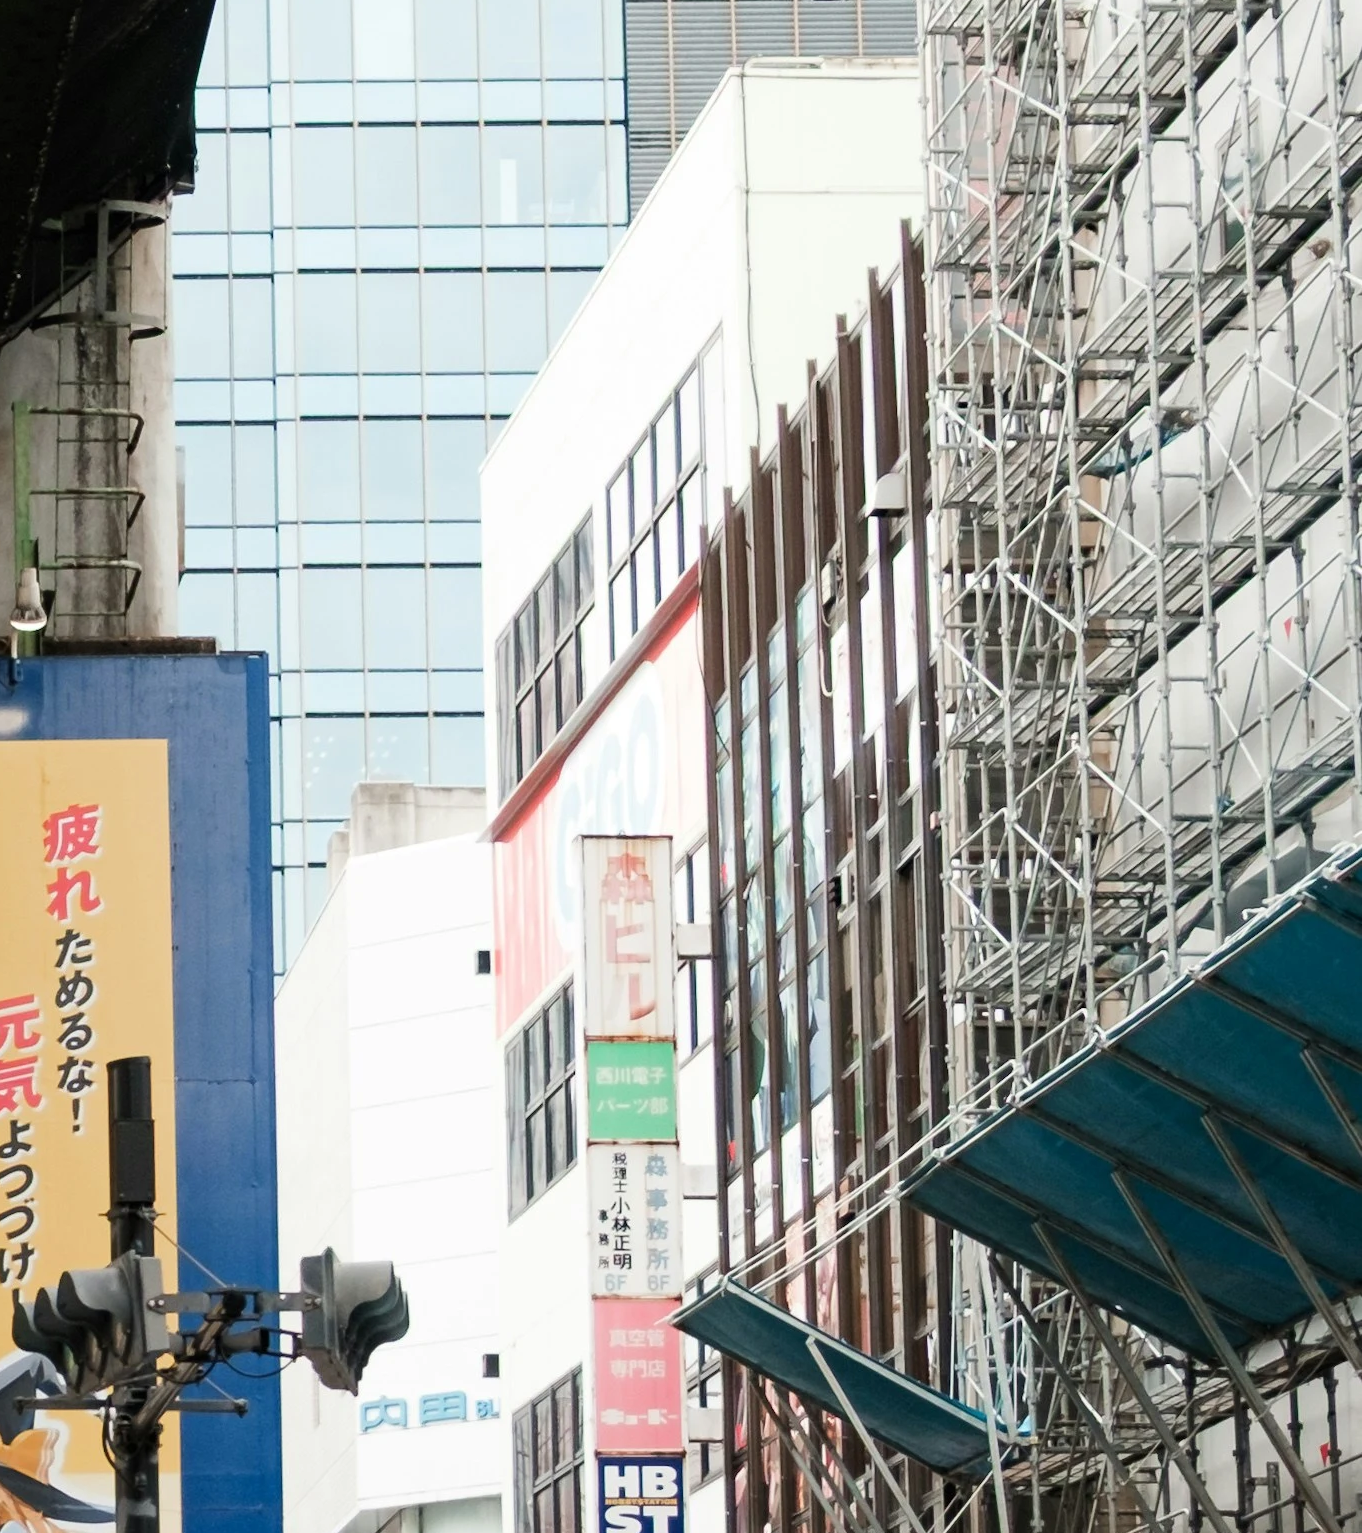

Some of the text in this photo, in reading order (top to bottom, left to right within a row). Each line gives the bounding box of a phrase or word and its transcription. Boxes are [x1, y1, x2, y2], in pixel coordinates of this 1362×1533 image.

[42, 803, 103, 1135] 疲れためるな!
[595, 1066, 668, 1086] 西川電子
[596, 1097, 669, 1116] パーツ部
[644, 1154, 671, 1270] 森事務所
[604, 1274, 628, 1293] 6F
[647, 1274, 671, 1292] 6F
[609, 1328, 666, 1349] 真空管
[609, 1359, 667, 1379] 専門店
[359, 1390, 468, 1435] 内田
[604, 1465, 679, 1499] HB
